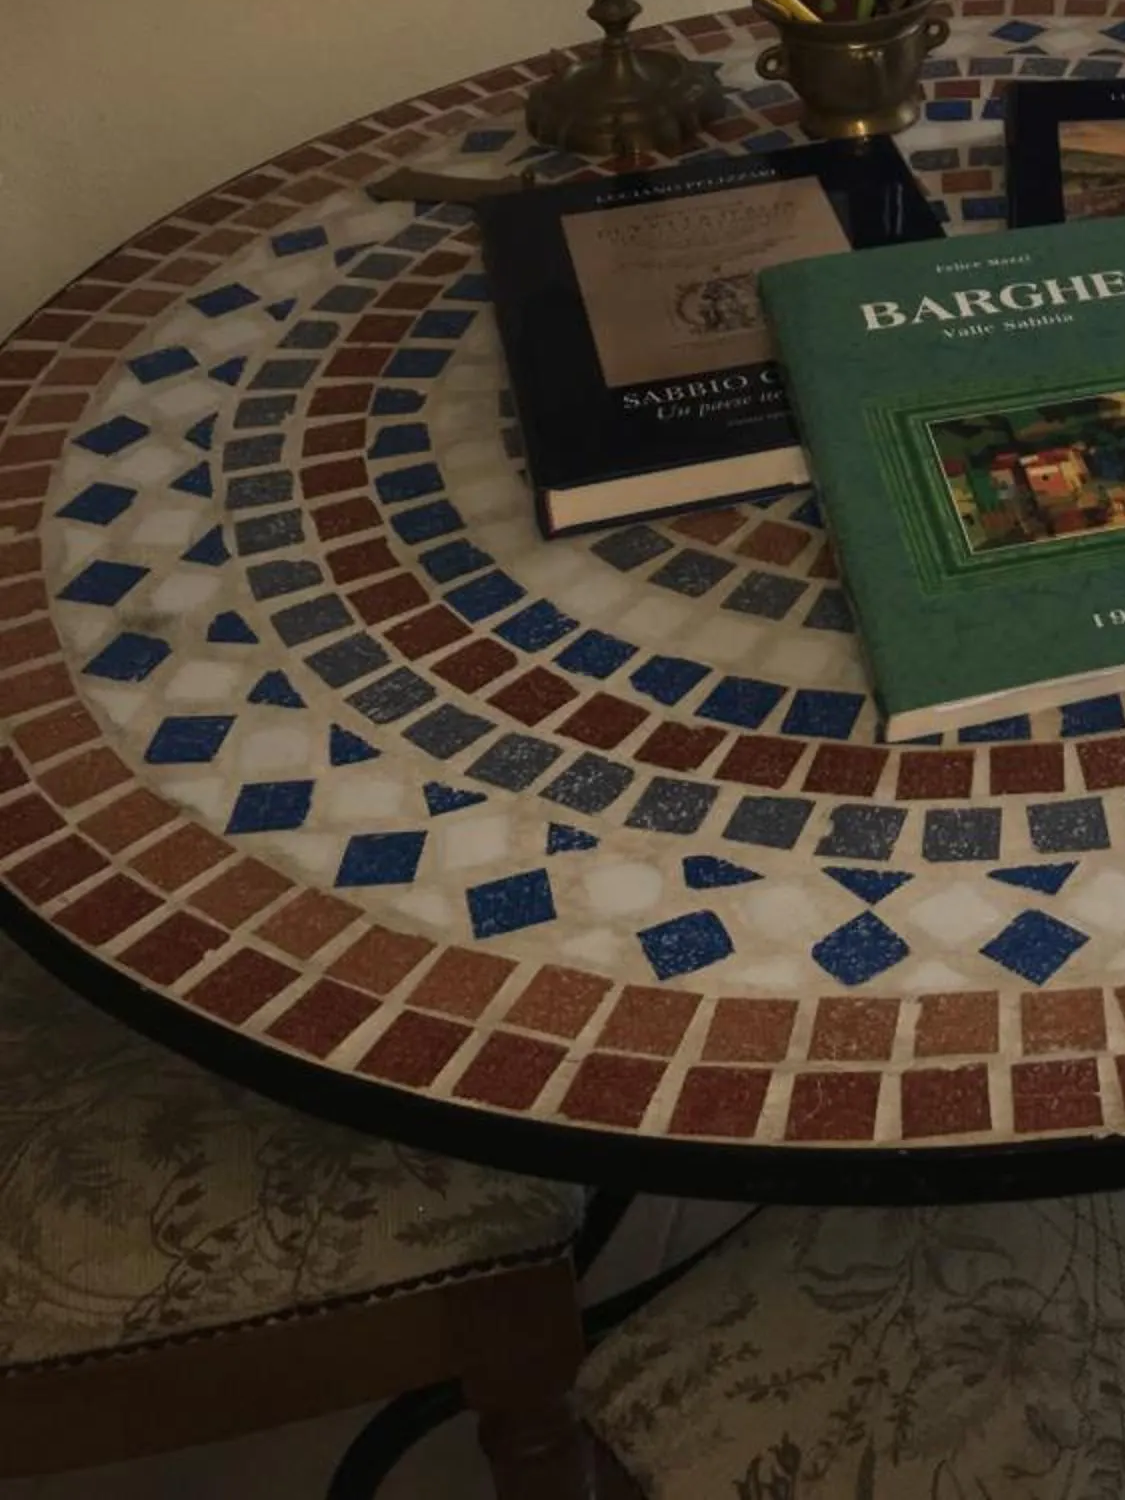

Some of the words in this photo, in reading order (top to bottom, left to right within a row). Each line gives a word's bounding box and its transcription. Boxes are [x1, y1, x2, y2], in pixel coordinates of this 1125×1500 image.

[935, 260, 982, 274] Felice
[942, 322, 996, 339] Valle
[1001, 312, 1076, 332] Sabbia
[622, 374, 749, 409] SABBIO
[656, 402, 692, 421] Un
[698, 394, 752, 418] paese
